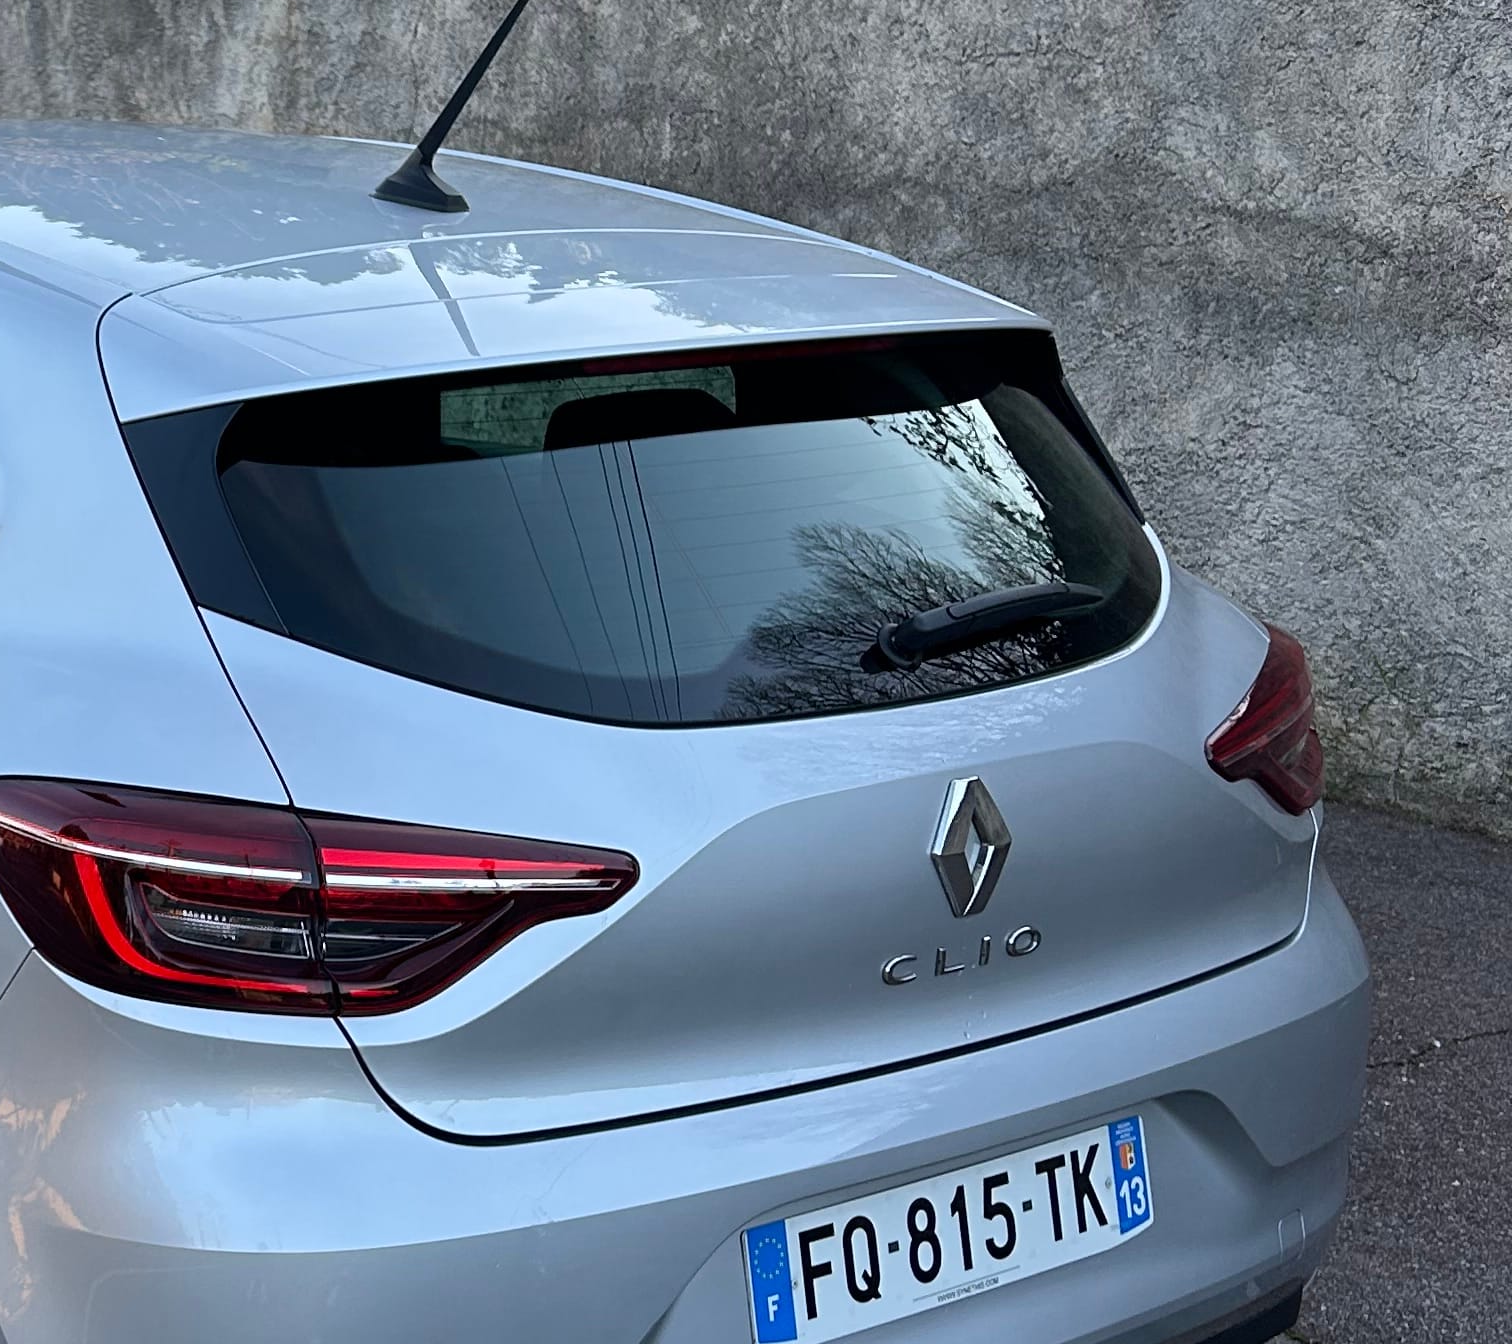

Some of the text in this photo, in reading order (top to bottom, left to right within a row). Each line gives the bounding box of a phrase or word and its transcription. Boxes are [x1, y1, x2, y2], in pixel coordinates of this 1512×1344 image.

[881, 925, 1042, 986] CLIO
[1119, 1175, 1147, 1219] 13
[799, 1143, 1108, 1321] FQ-815-TK
[767, 1294, 781, 1323] F
